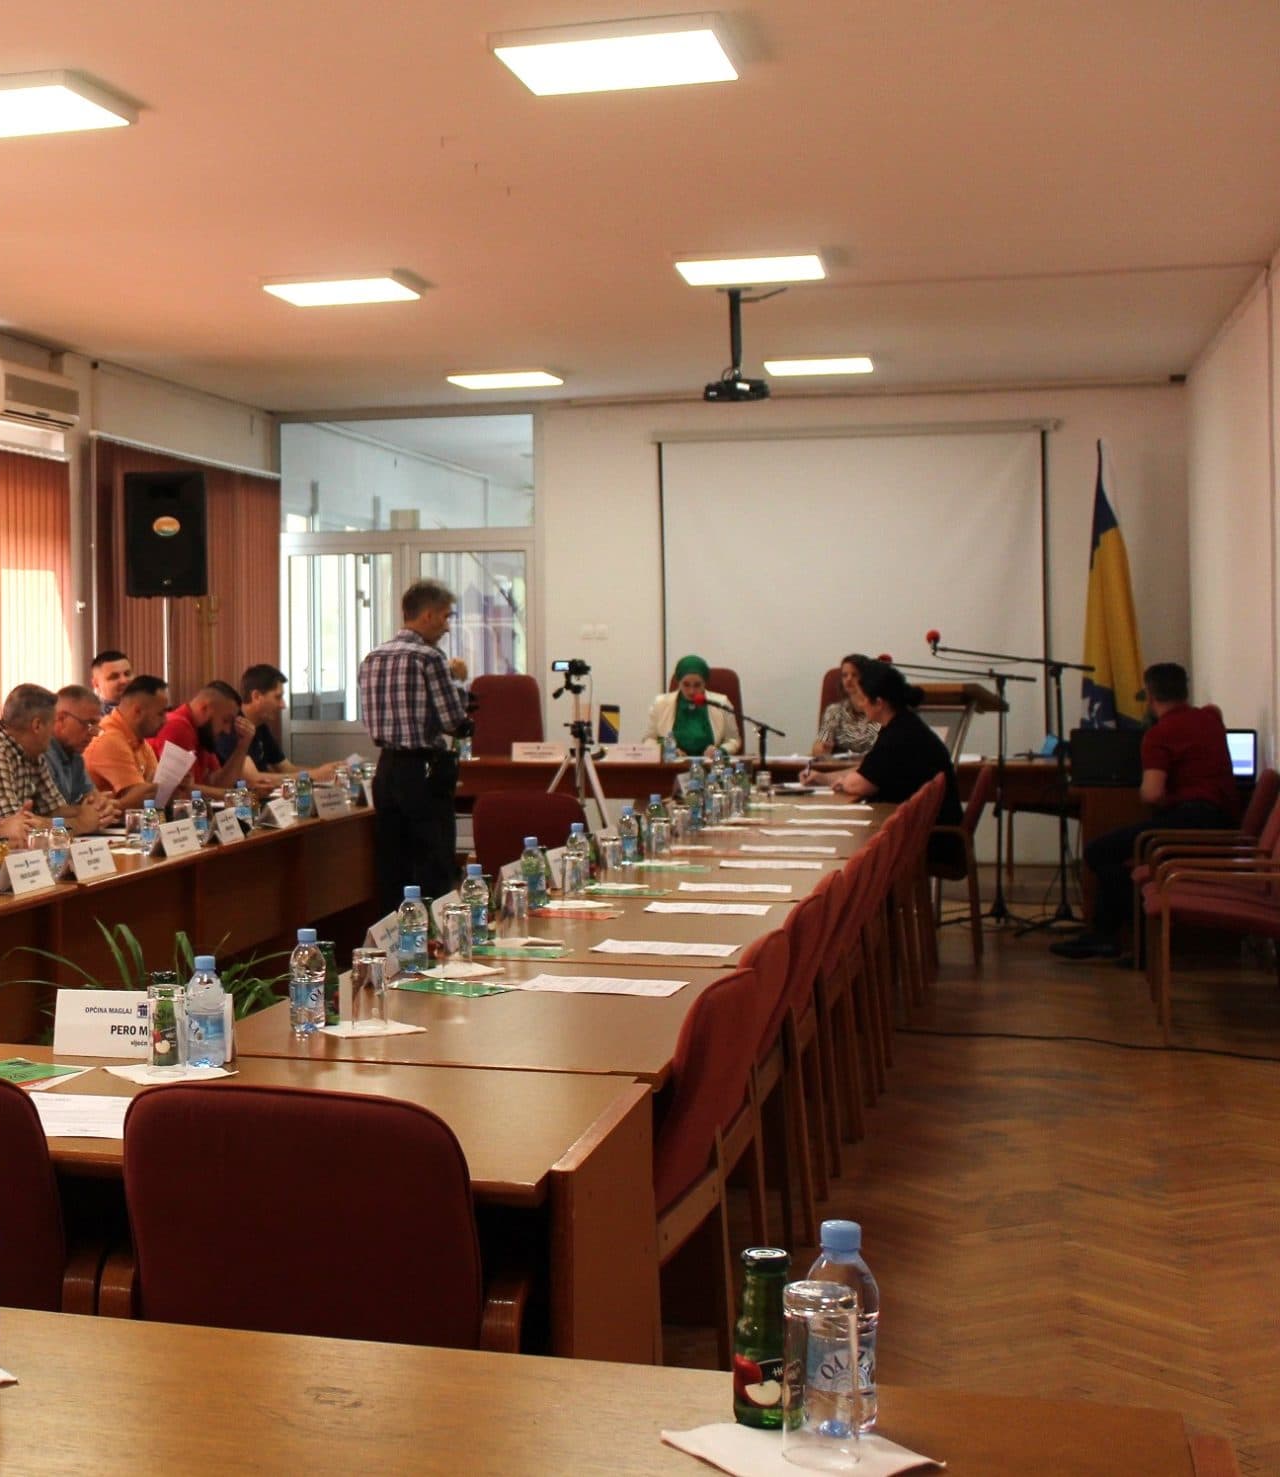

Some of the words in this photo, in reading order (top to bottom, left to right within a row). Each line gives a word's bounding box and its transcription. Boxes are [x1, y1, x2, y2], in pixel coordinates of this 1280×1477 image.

[108, 1006, 133, 1015] MAGLAJ
[110, 1024, 137, 1036] PERO
[138, 1026, 148, 1037] M
